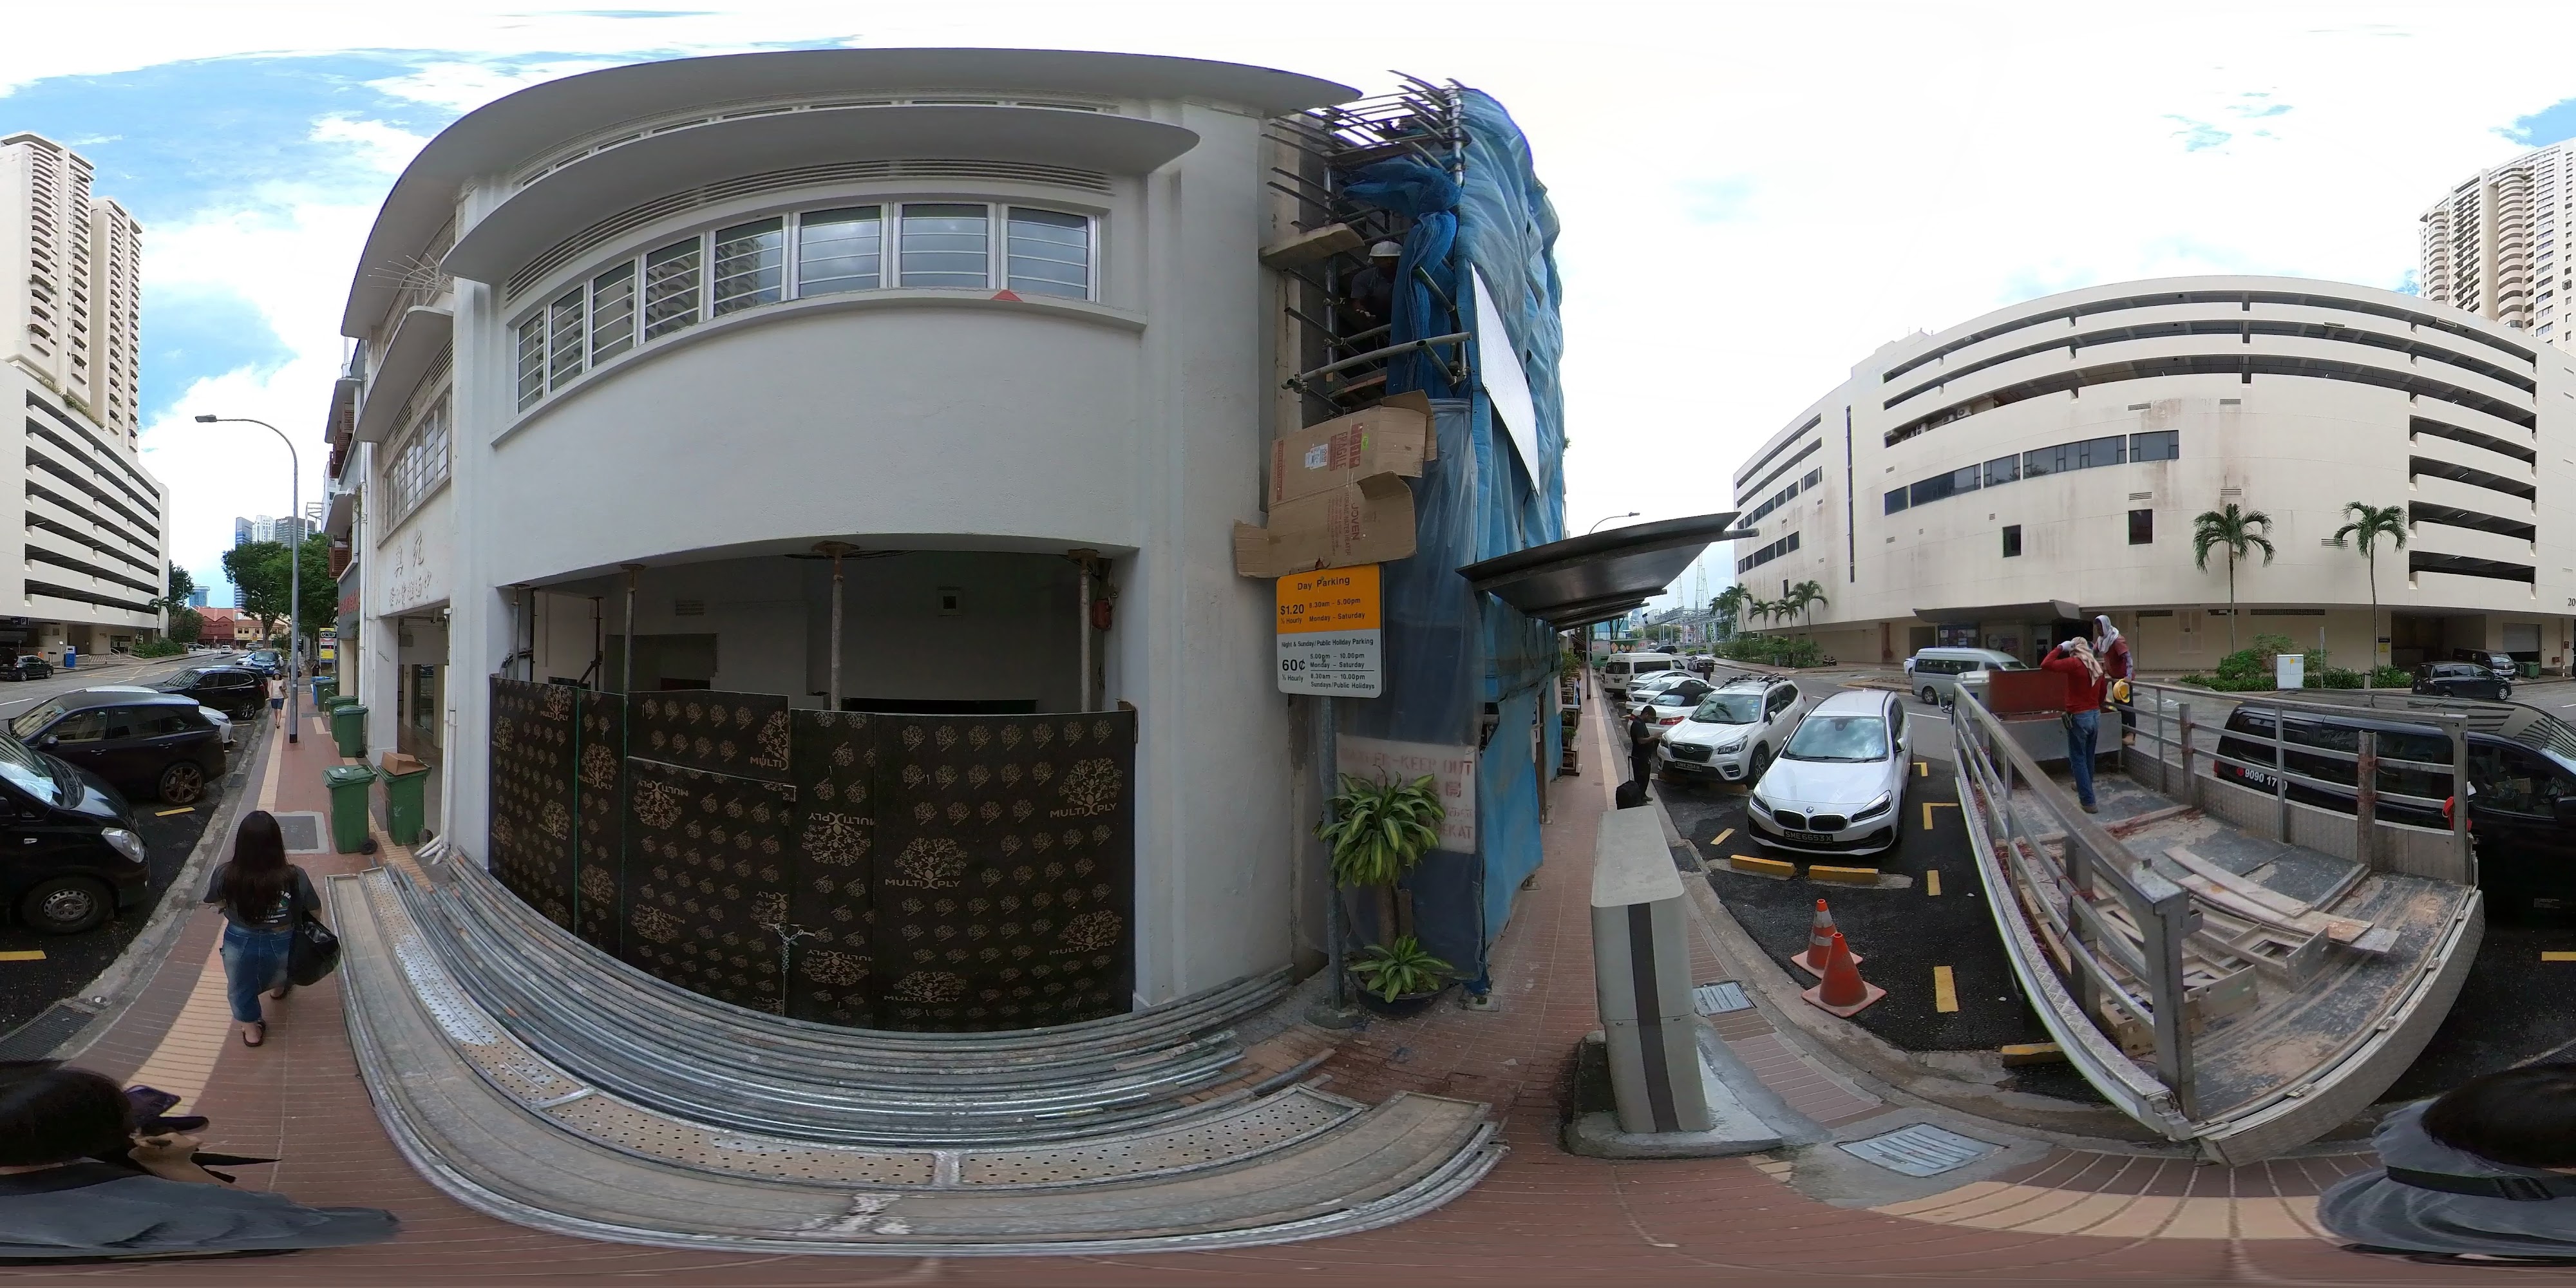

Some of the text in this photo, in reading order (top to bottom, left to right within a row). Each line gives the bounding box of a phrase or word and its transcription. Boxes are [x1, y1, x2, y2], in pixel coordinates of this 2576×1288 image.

[1336, 431, 1348, 469] FRAGILE
[1351, 502, 1360, 541] JOVEN
[1298, 577, 1350, 591] Day Parking
[1280, 603, 1304, 616] $1.20
[2245, 768, 2264, 783] 9090
[1785, 831, 1832, 842] SME6653X
